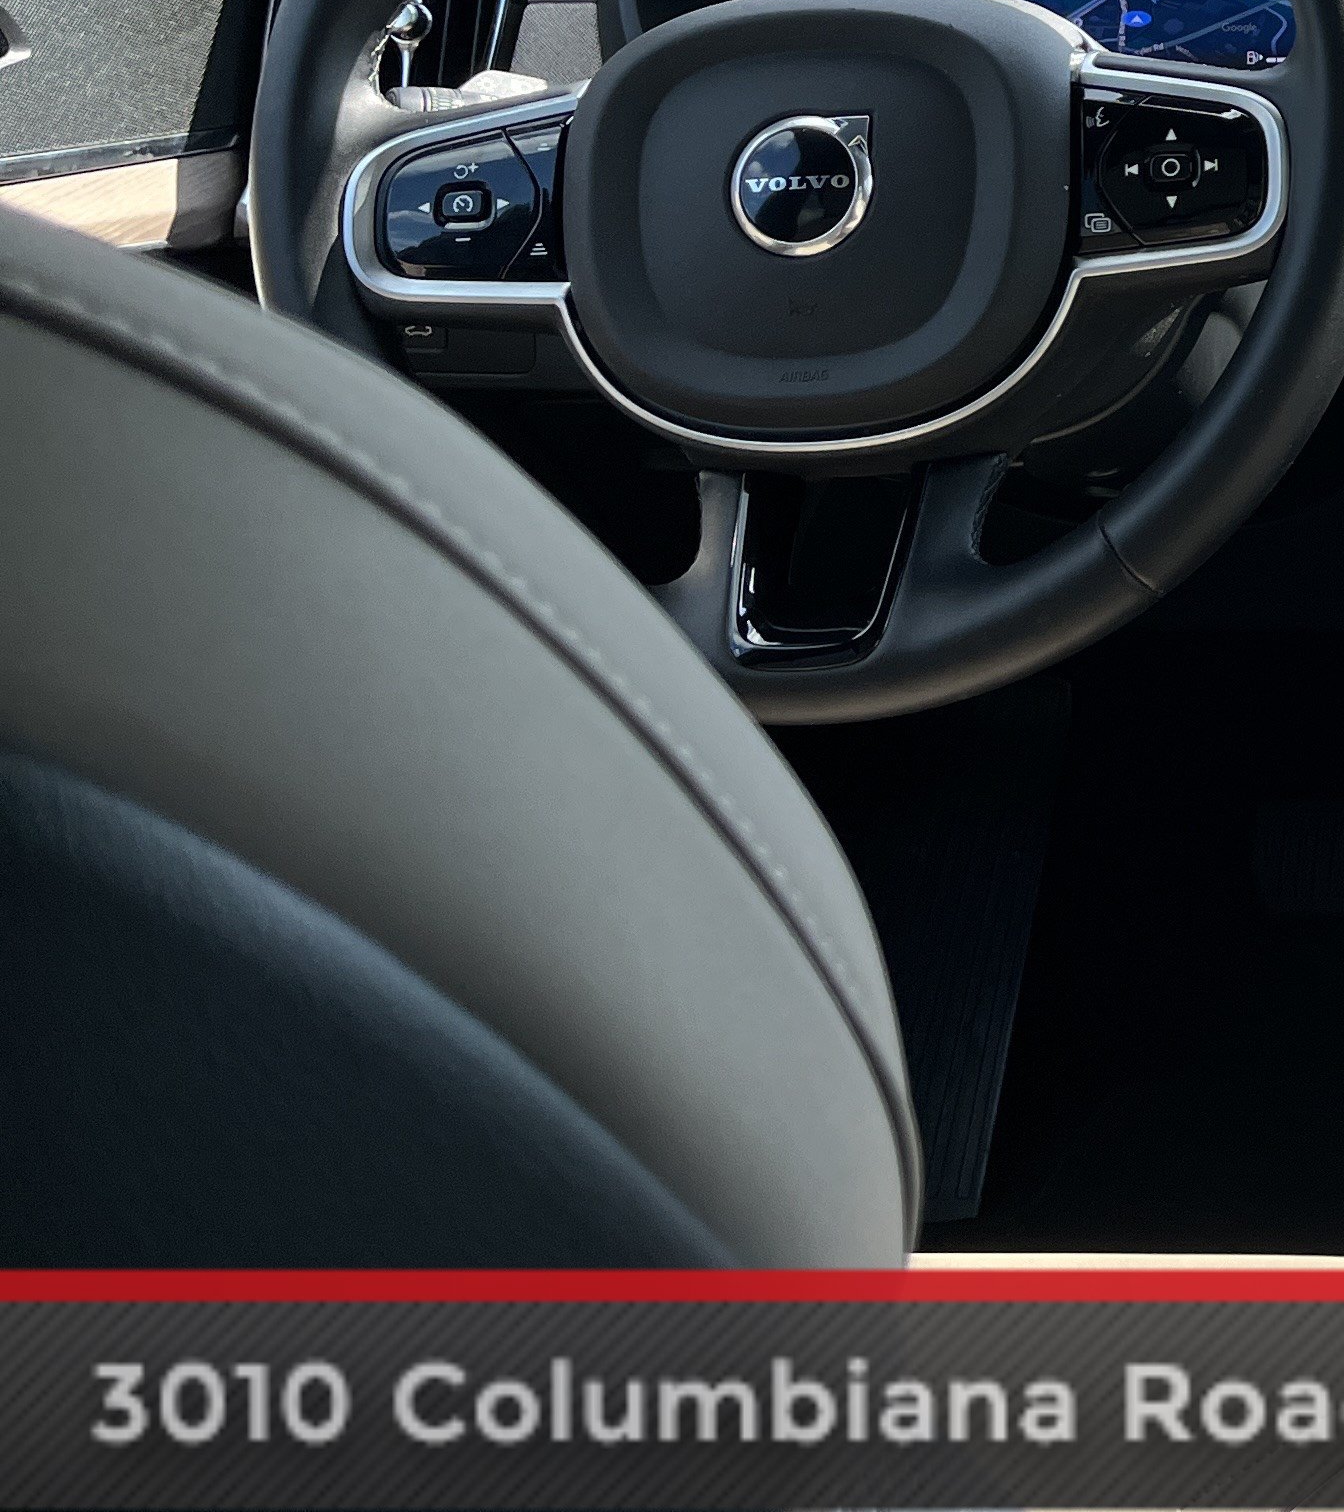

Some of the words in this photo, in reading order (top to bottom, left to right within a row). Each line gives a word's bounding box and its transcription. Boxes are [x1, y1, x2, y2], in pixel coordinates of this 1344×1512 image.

[1221, 21, 1258, 34] Google
[744, 174, 851, 194] VOLVO
[778, 369, 830, 383] AIRBAG
